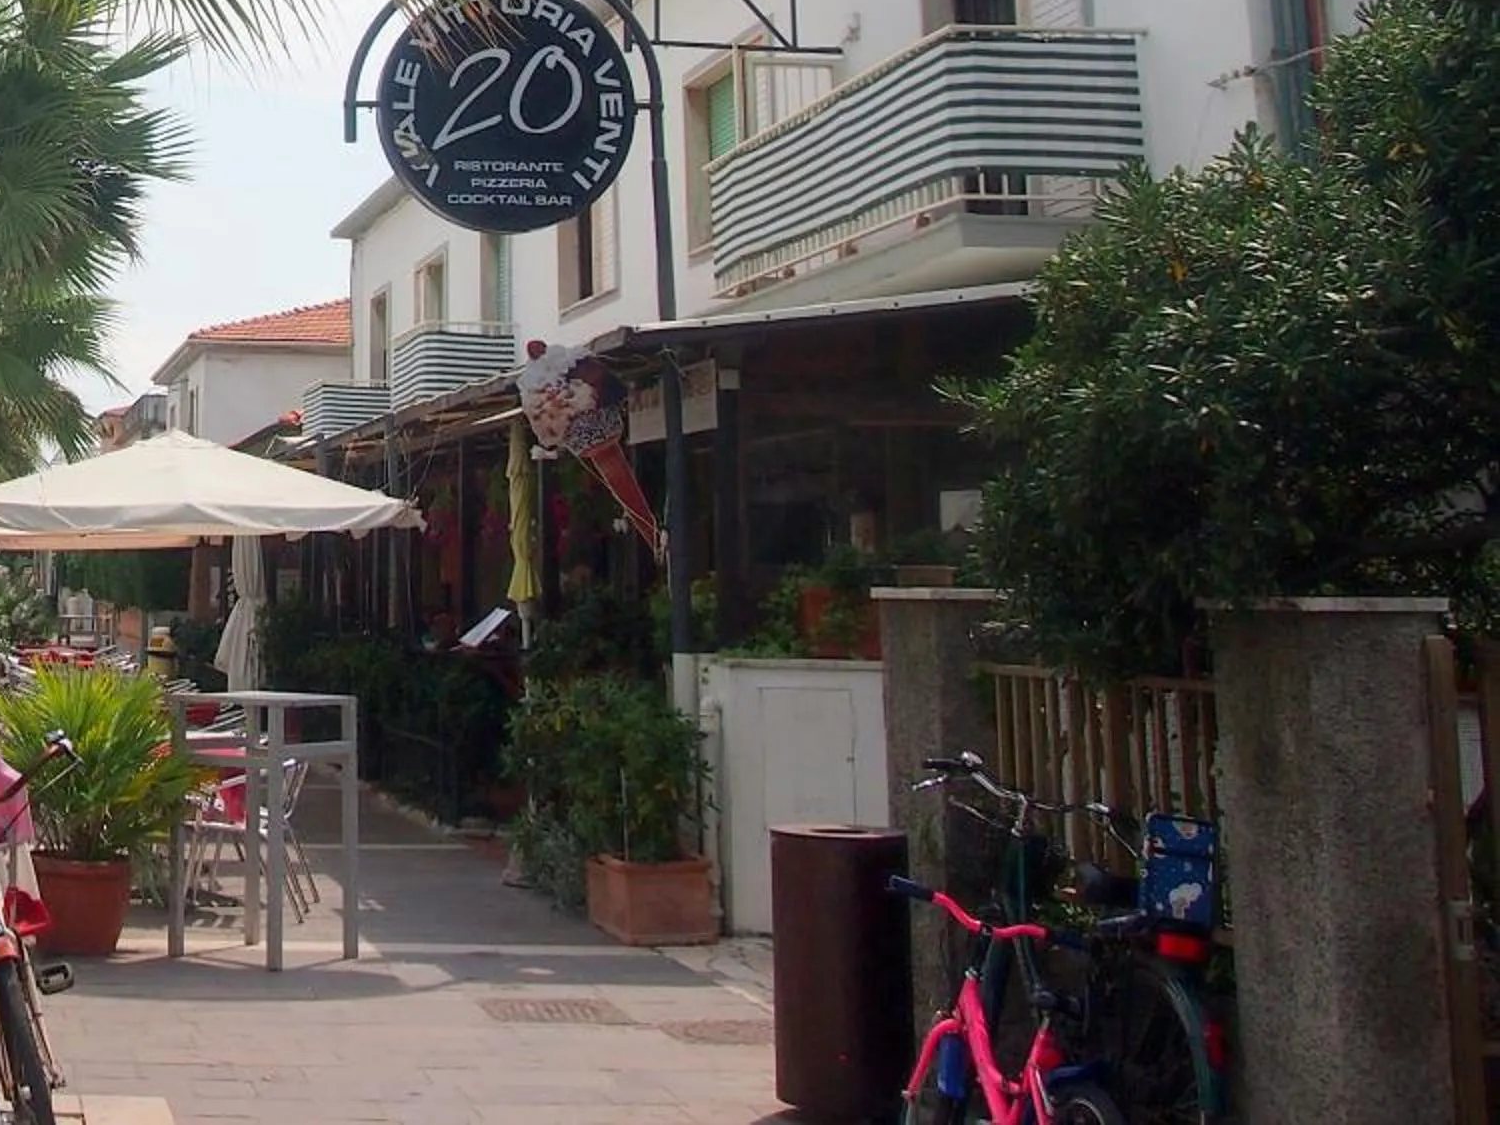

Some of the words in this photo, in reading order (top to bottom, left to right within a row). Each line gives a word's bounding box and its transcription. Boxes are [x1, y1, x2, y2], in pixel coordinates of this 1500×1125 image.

[431, 44, 583, 151] 20
[392, 57, 440, 189] VALE
[571, 58, 624, 191] VENTI
[453, 160, 565, 173] RISTORANTE
[470, 177, 548, 189] PIZZERIA
[447, 194, 532, 205] COCKTAIL
[534, 195, 573, 206] BAR
